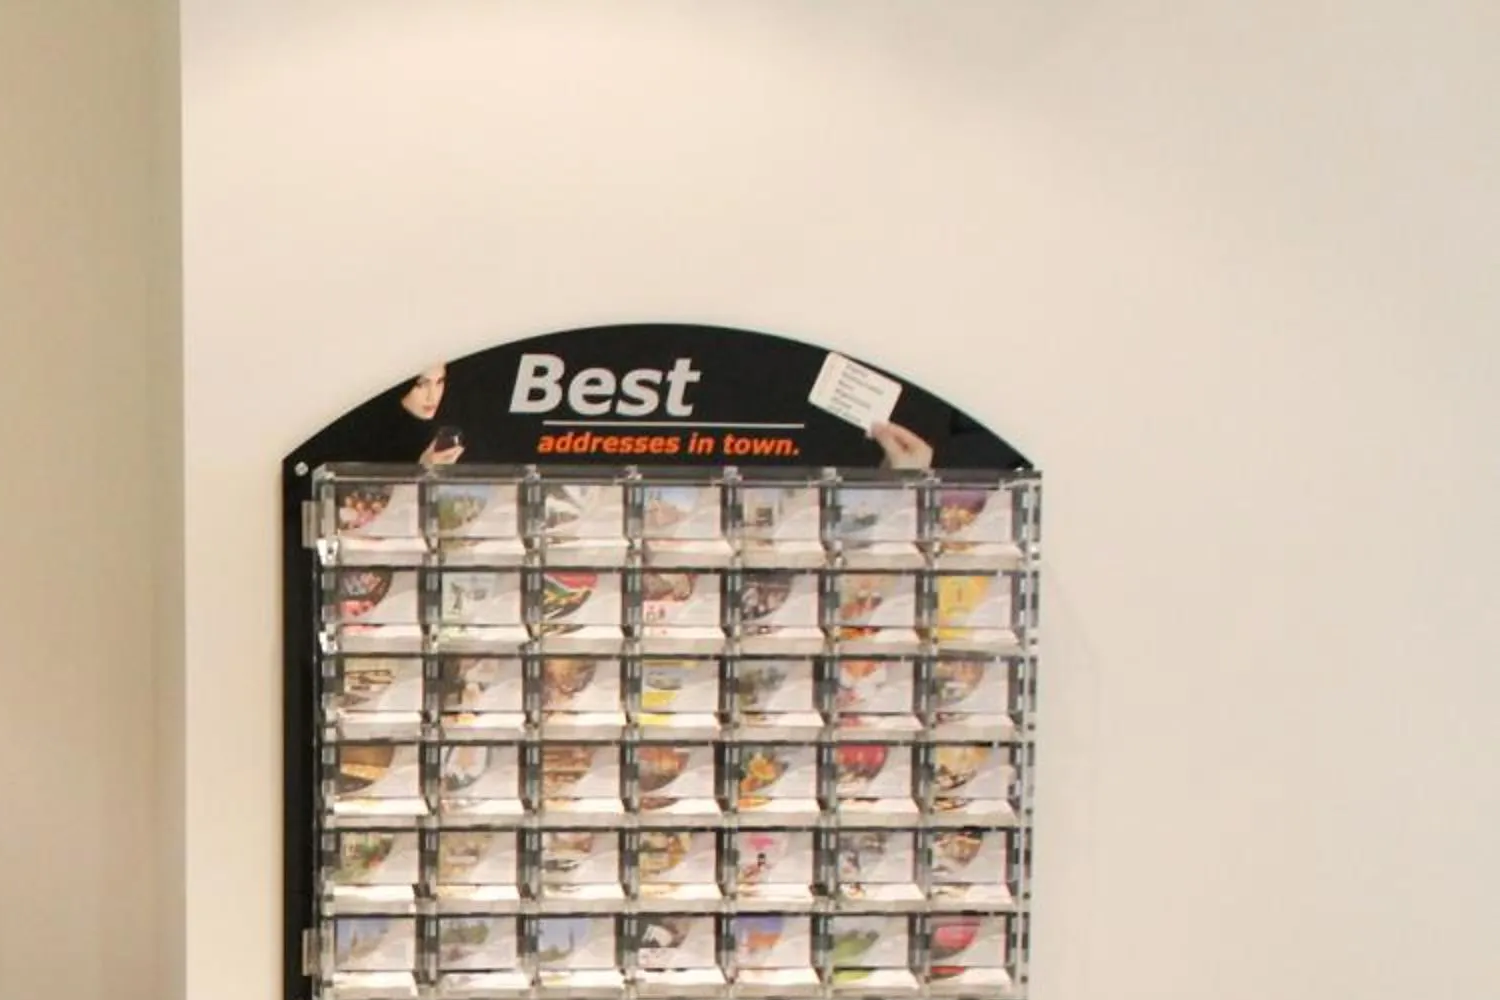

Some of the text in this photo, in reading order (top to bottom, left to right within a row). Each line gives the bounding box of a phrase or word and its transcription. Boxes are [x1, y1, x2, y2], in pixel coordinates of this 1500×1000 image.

[509, 353, 701, 417] Best
[537, 432, 801, 456] addresses in town.
